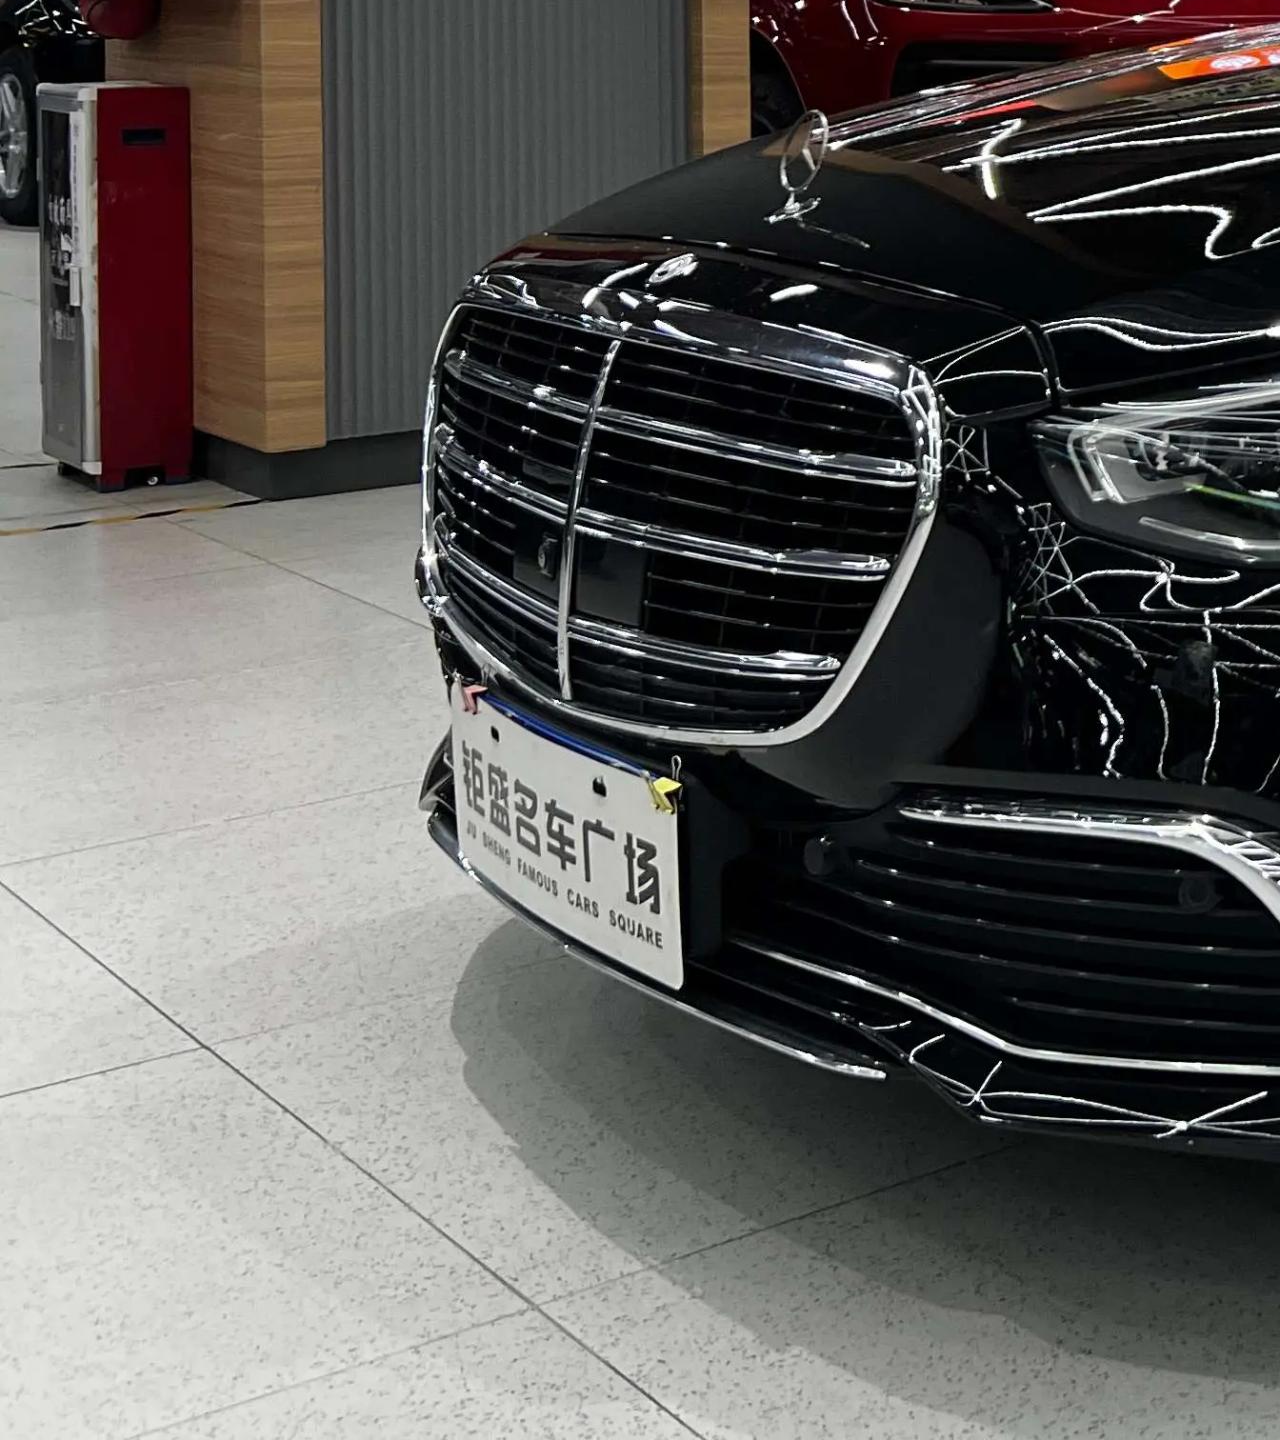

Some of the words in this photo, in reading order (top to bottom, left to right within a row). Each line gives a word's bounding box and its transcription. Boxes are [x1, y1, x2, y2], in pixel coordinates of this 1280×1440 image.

[462, 740, 661, 915] 钜盛名车广场
[517, 857, 559, 898] FAMOUS
[567, 889, 600, 919] CARS
[608, 909, 664, 950] SQUARE
